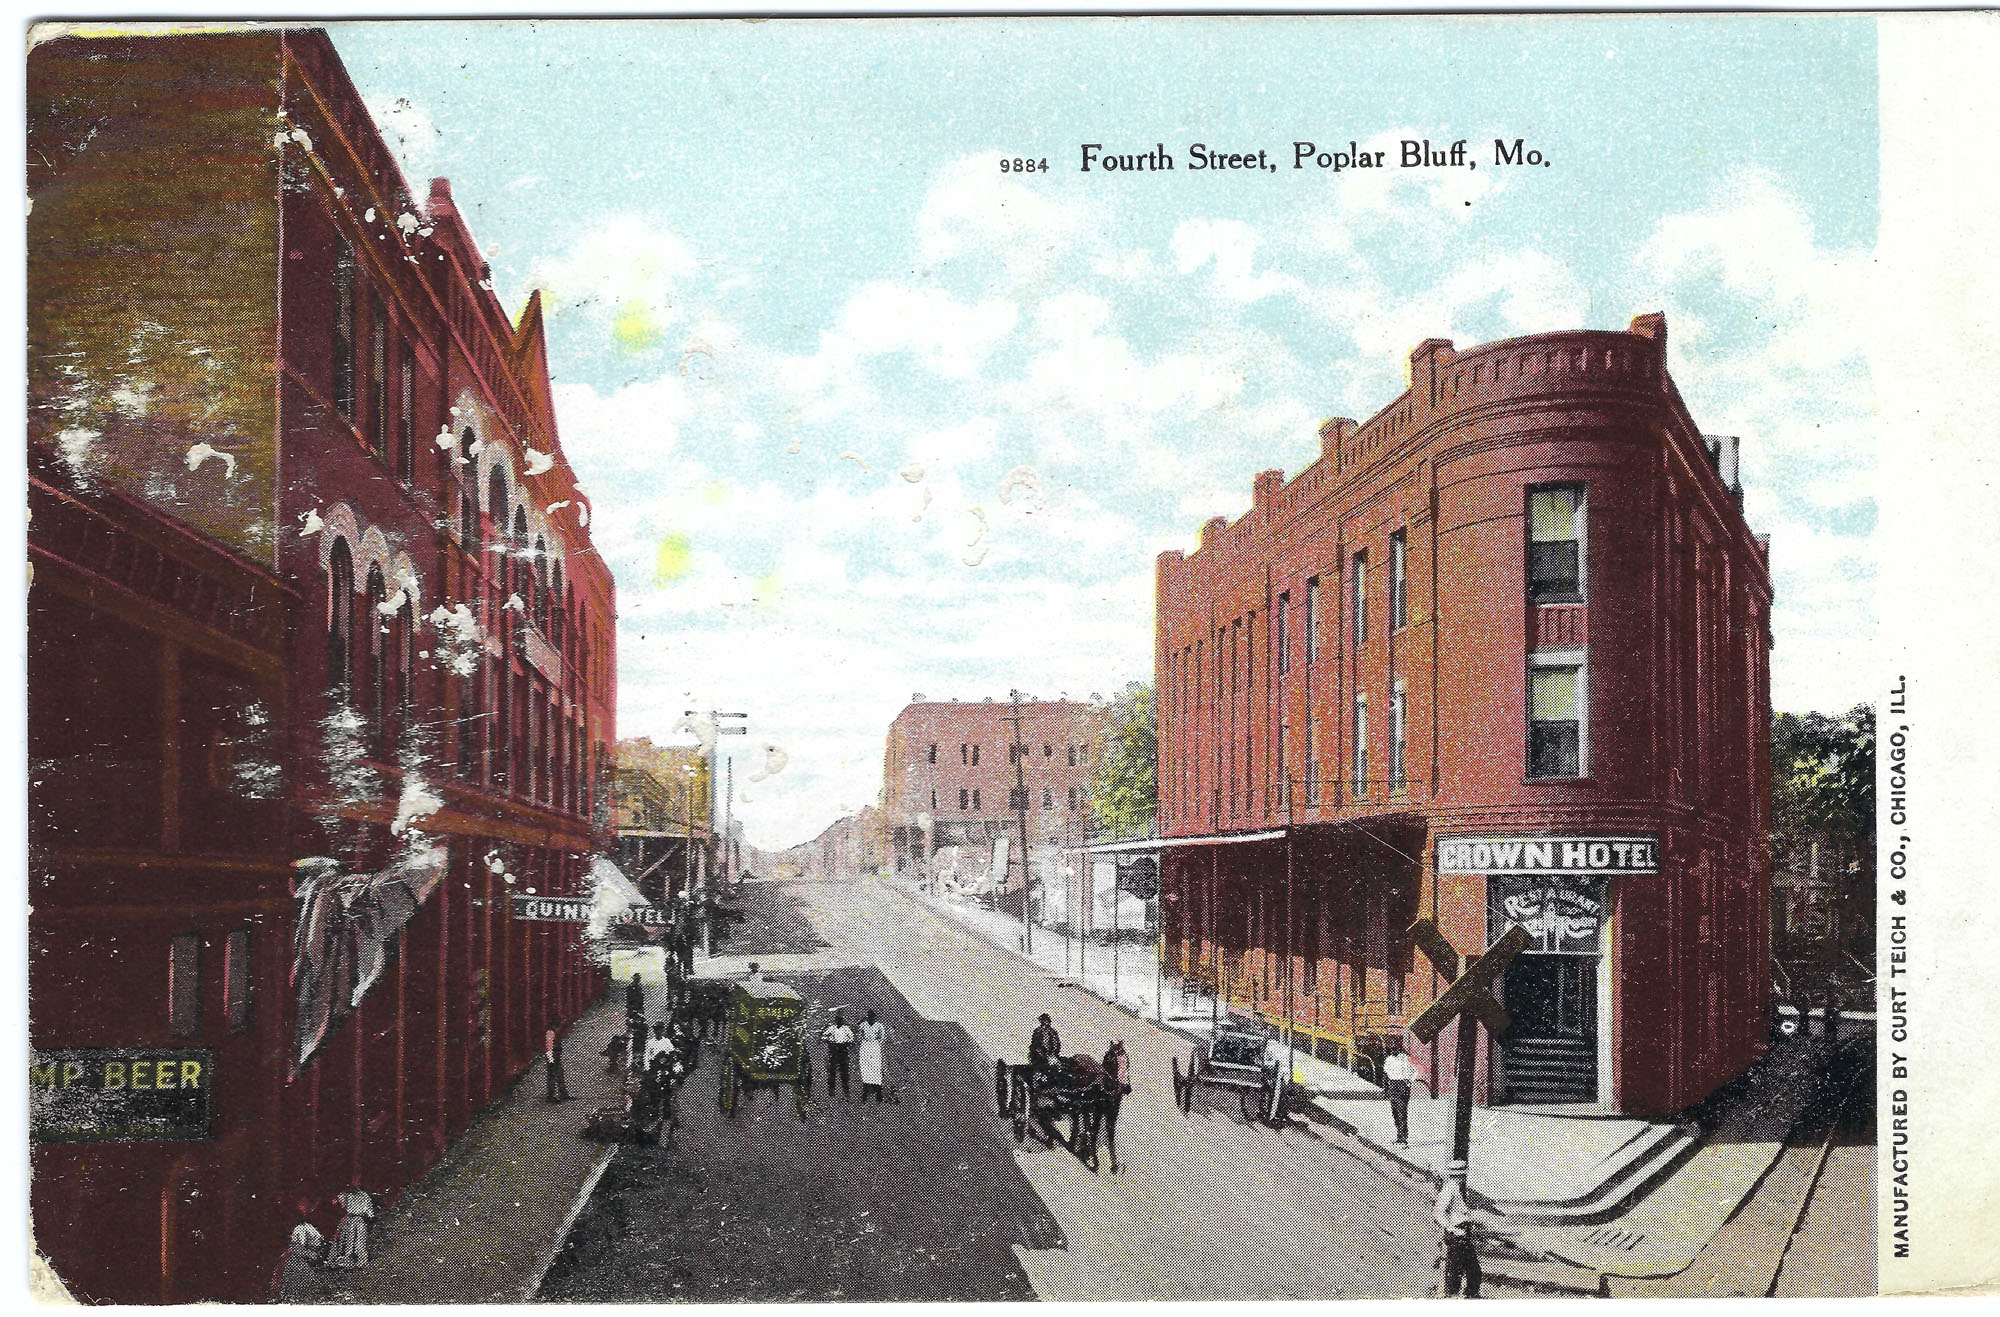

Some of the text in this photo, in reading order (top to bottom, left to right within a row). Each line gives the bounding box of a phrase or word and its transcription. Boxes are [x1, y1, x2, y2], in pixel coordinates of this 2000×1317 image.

[1439, 842, 1657, 869] CROWN HOTEL
[104, 1060, 201, 1090] BEER
